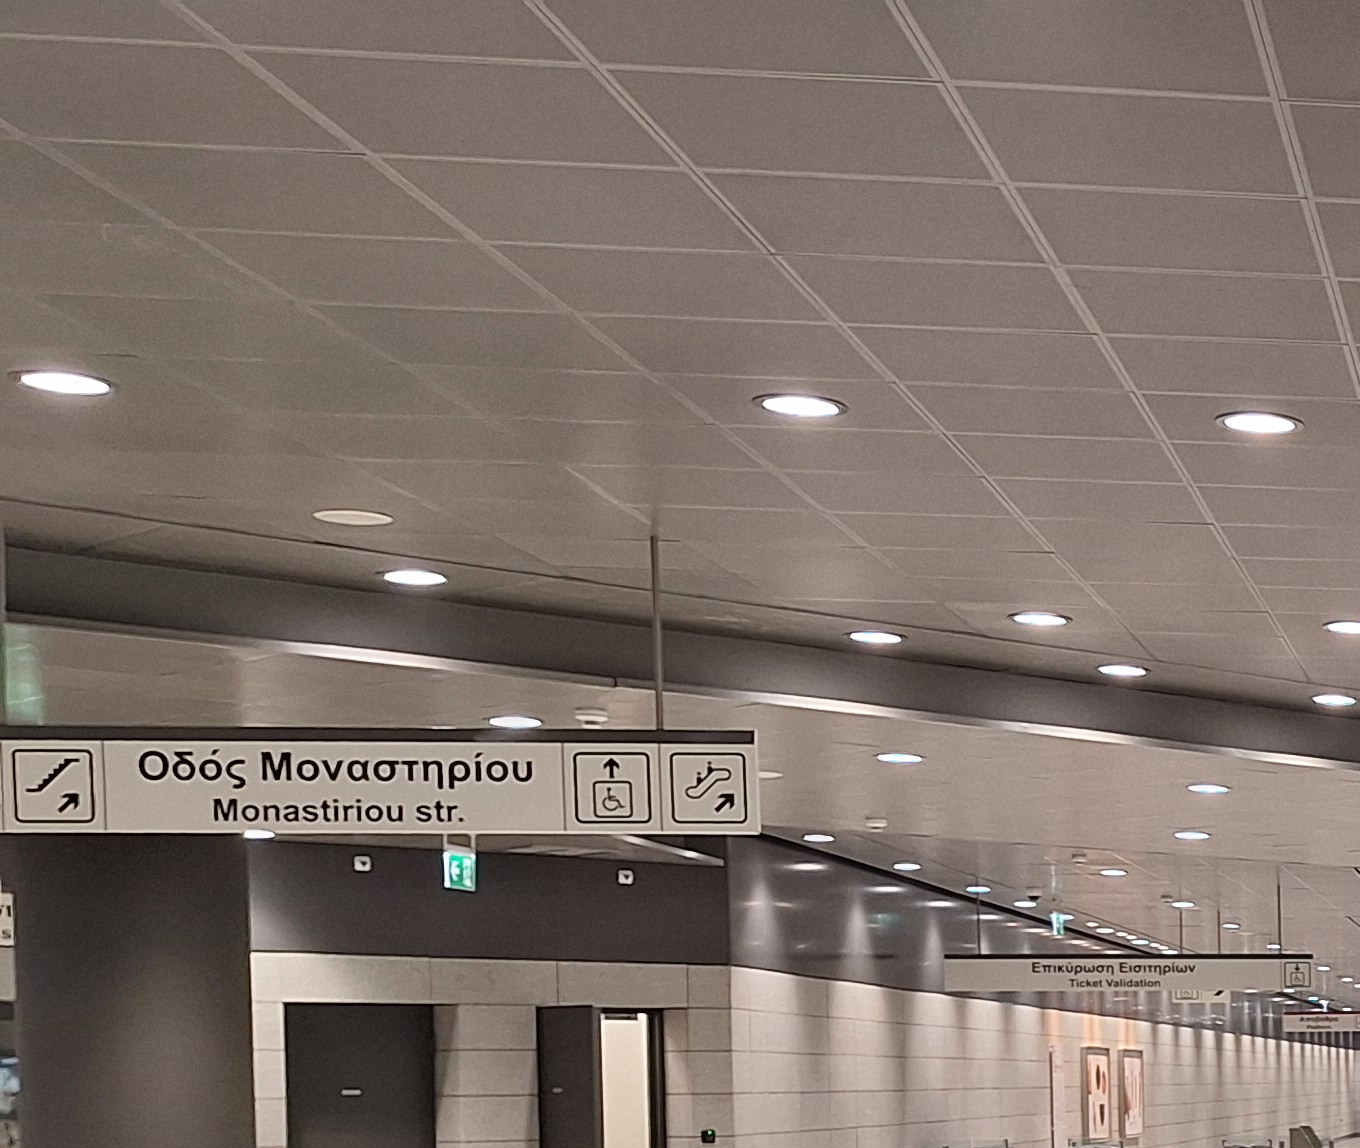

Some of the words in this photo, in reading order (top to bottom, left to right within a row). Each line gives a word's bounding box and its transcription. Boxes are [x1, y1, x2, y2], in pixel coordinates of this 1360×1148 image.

[138, 749, 246, 788] Οδός
[261, 750, 533, 789] Μοναστηρίου
[213, 799, 403, 822] Monastiriou
[416, 799, 465, 822] str.
[1031, 962, 1114, 975] Επικύρωση
[1119, 961, 1196, 975] Εισιτηρίων
[1069, 979, 1103, 988] Ticket
[1106, 979, 1161, 988] Validation
